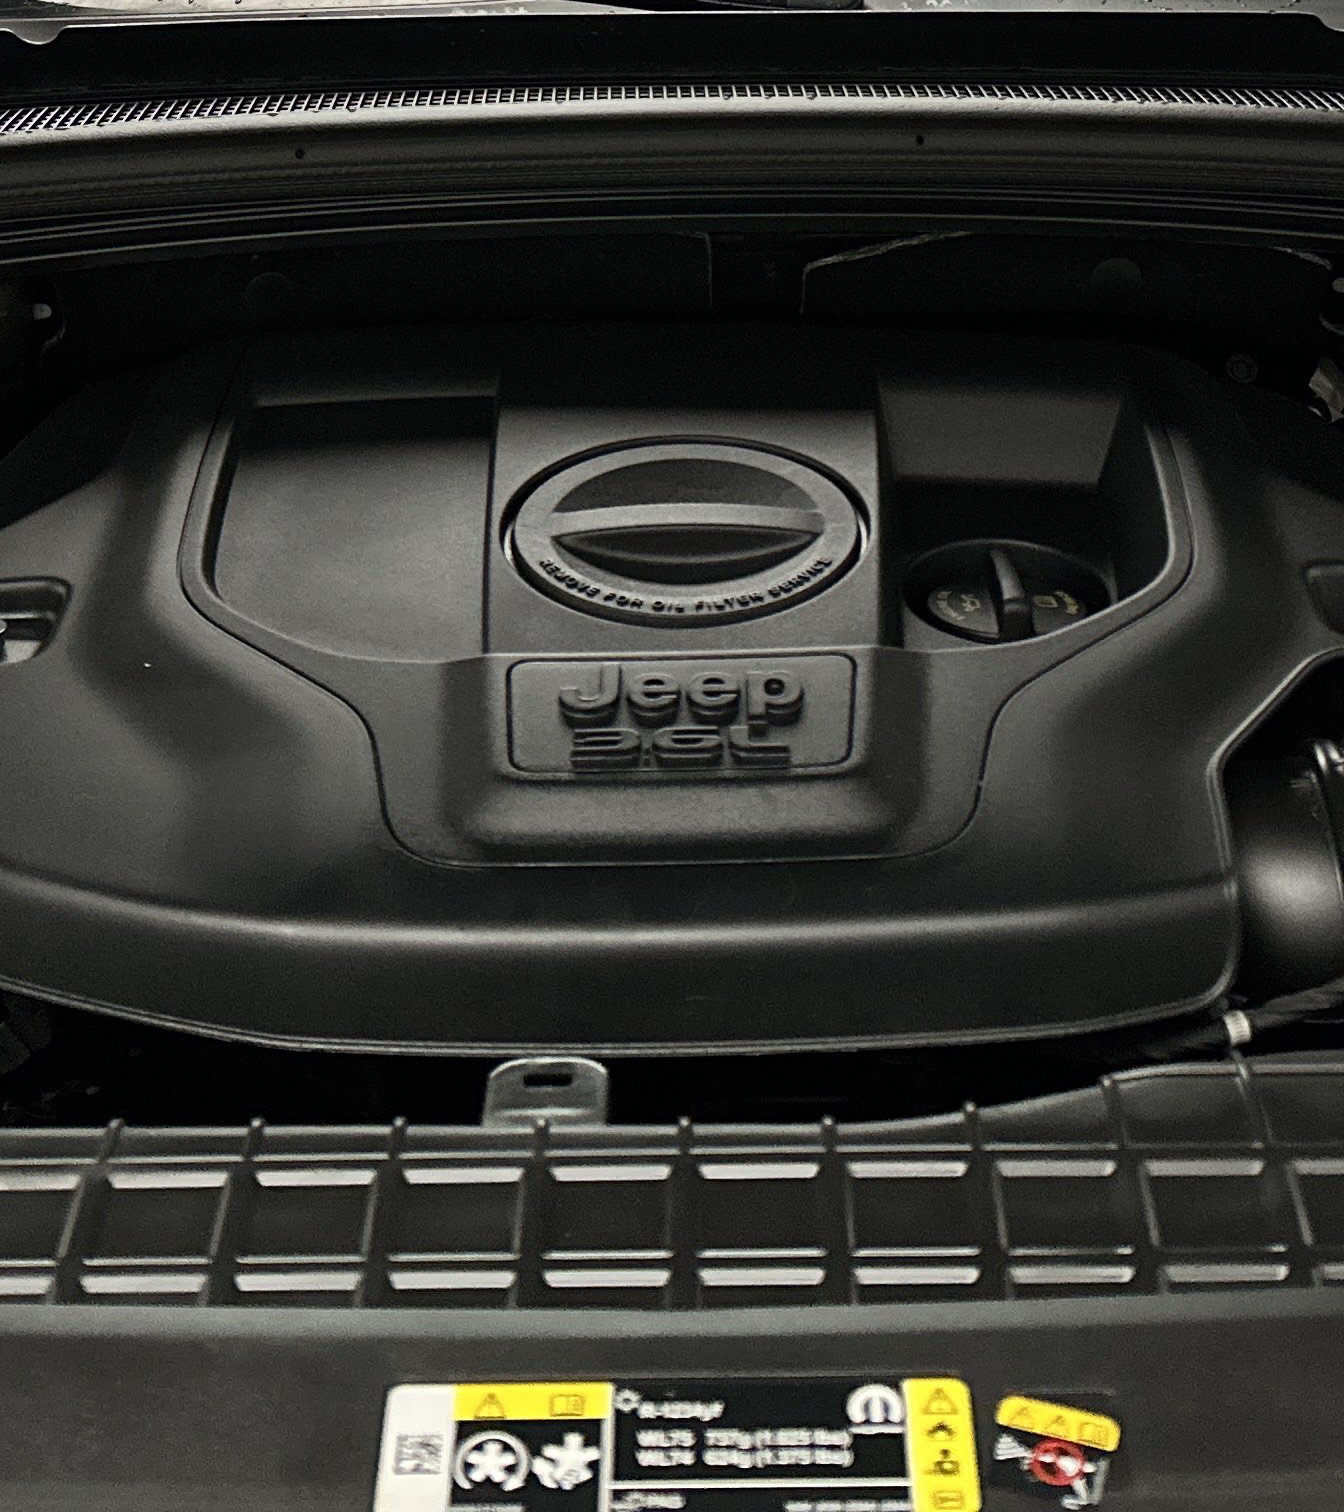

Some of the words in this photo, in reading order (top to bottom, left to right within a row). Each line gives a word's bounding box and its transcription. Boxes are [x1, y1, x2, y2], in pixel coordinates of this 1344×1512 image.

[539, 557, 601, 597] REMOVE
[603, 591, 644, 610] FOR
[652, 599, 685, 614] OIL
[695, 591, 765, 613] FILTER
[768, 557, 834, 598] SERVICE
[558, 664, 805, 726] Jeep
